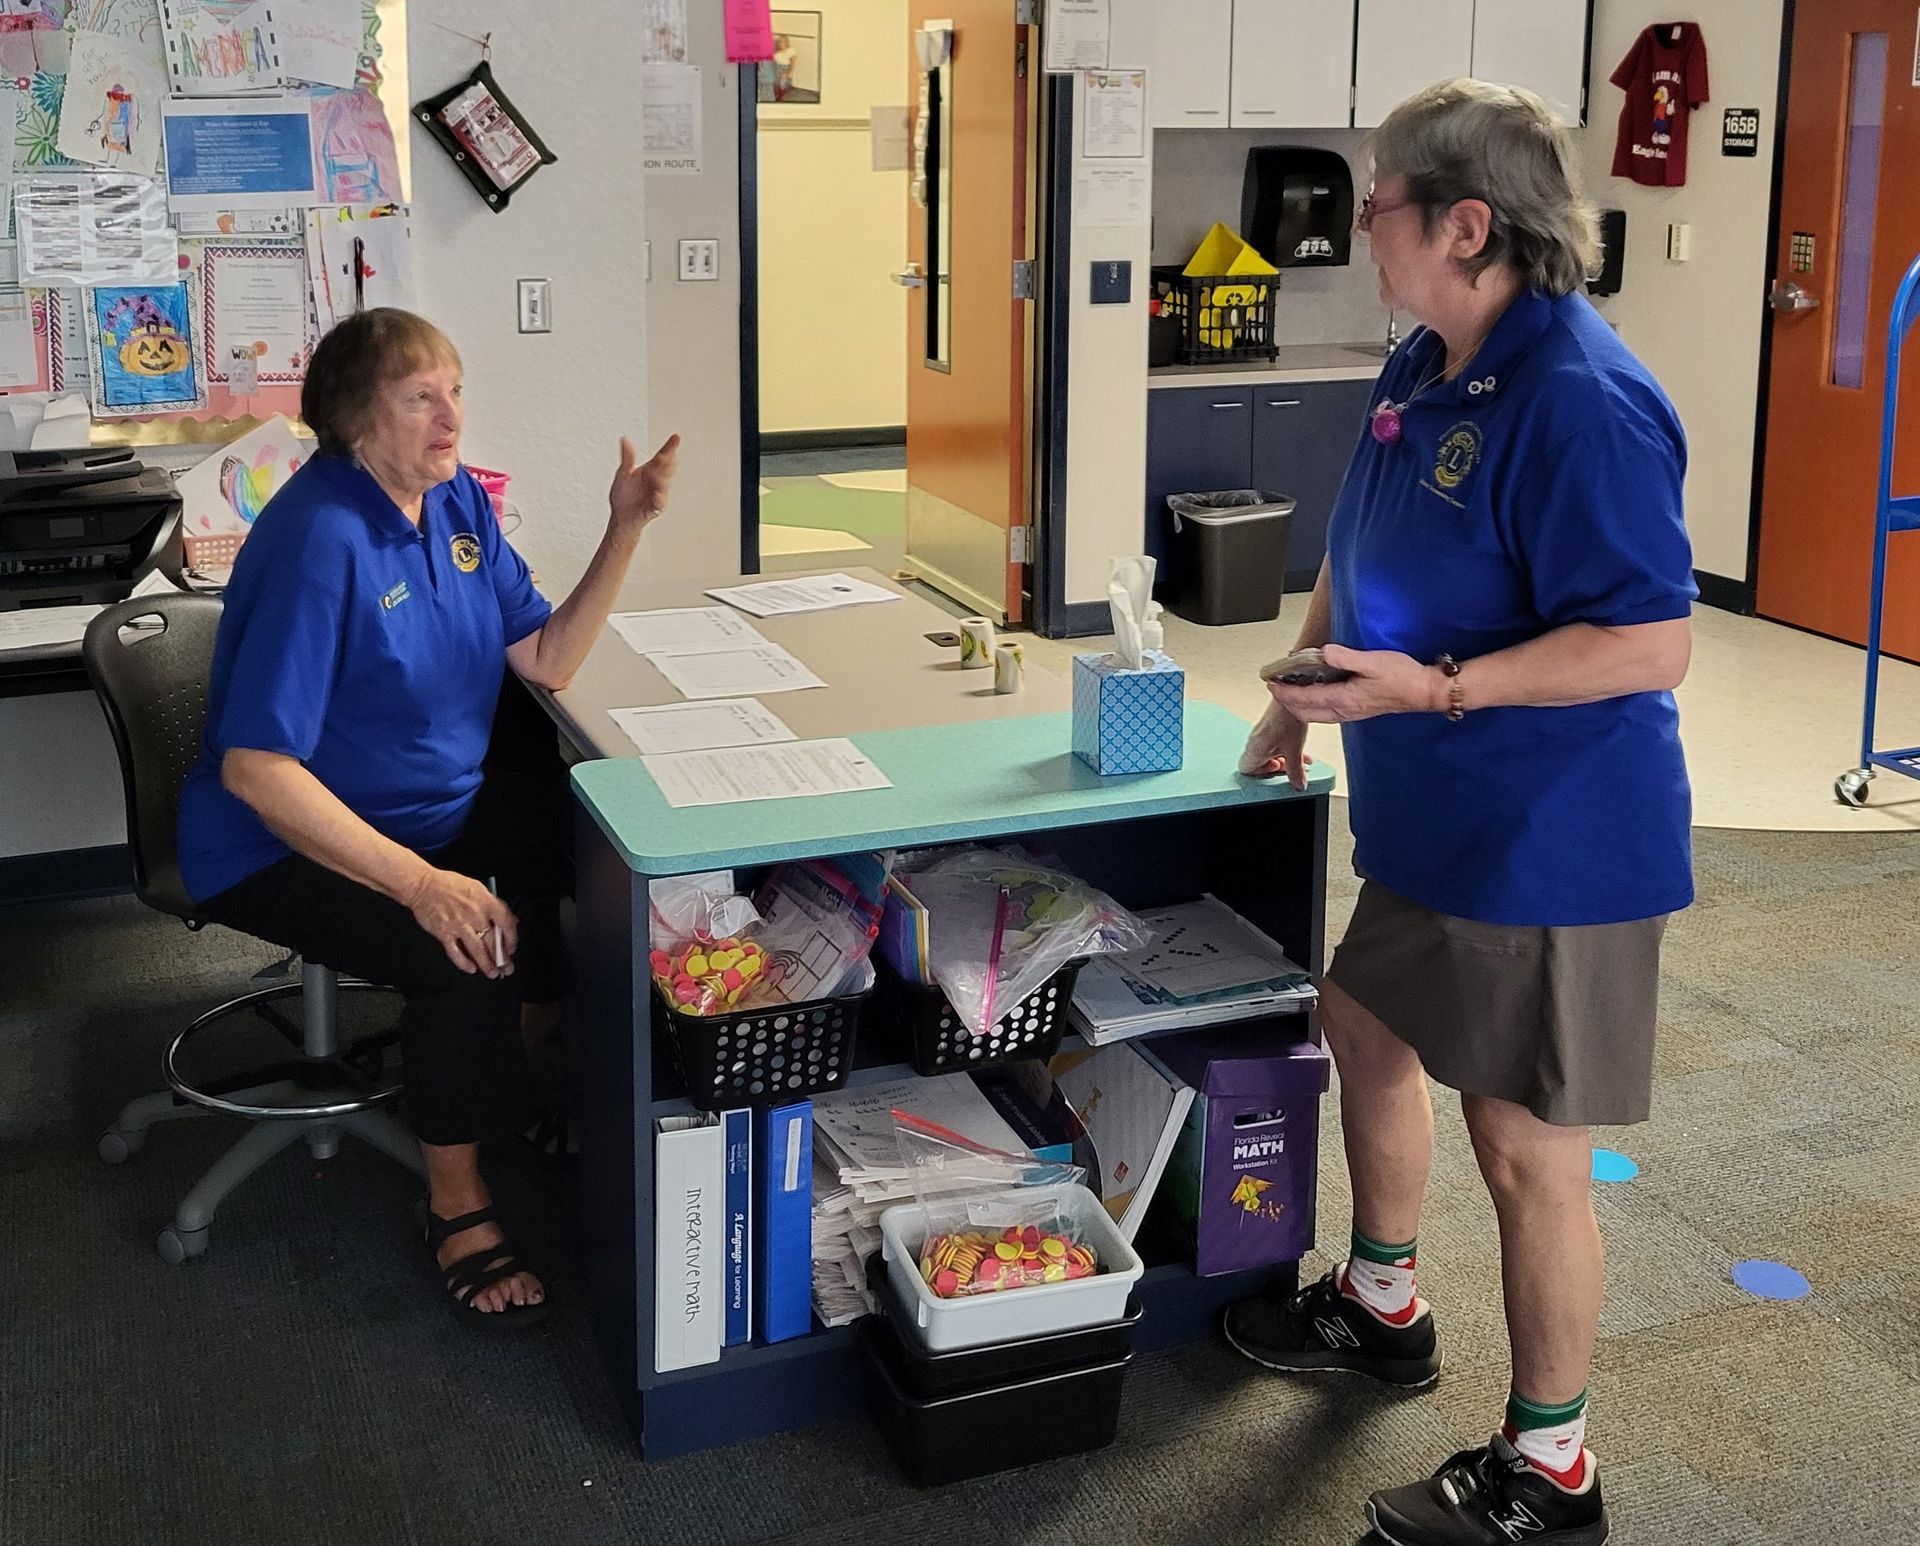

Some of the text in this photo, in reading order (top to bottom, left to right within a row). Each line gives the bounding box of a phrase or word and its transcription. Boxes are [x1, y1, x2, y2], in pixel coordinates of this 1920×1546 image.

[180, 26, 271, 78] AMERICA
[1724, 116, 1757, 134] 165B
[1724, 138, 1755, 147] STORAGE
[665, 159, 697, 168] ROUTE
[1235, 1132, 1284, 1145] Florida Reveal
[1233, 1140, 1284, 1160] MATH
[1233, 1160, 1269, 1170] Workstation
[730, 1222, 744, 1264] Language
[733, 1265, 742, 1275] for
[732, 1275, 743, 1309] Learning
